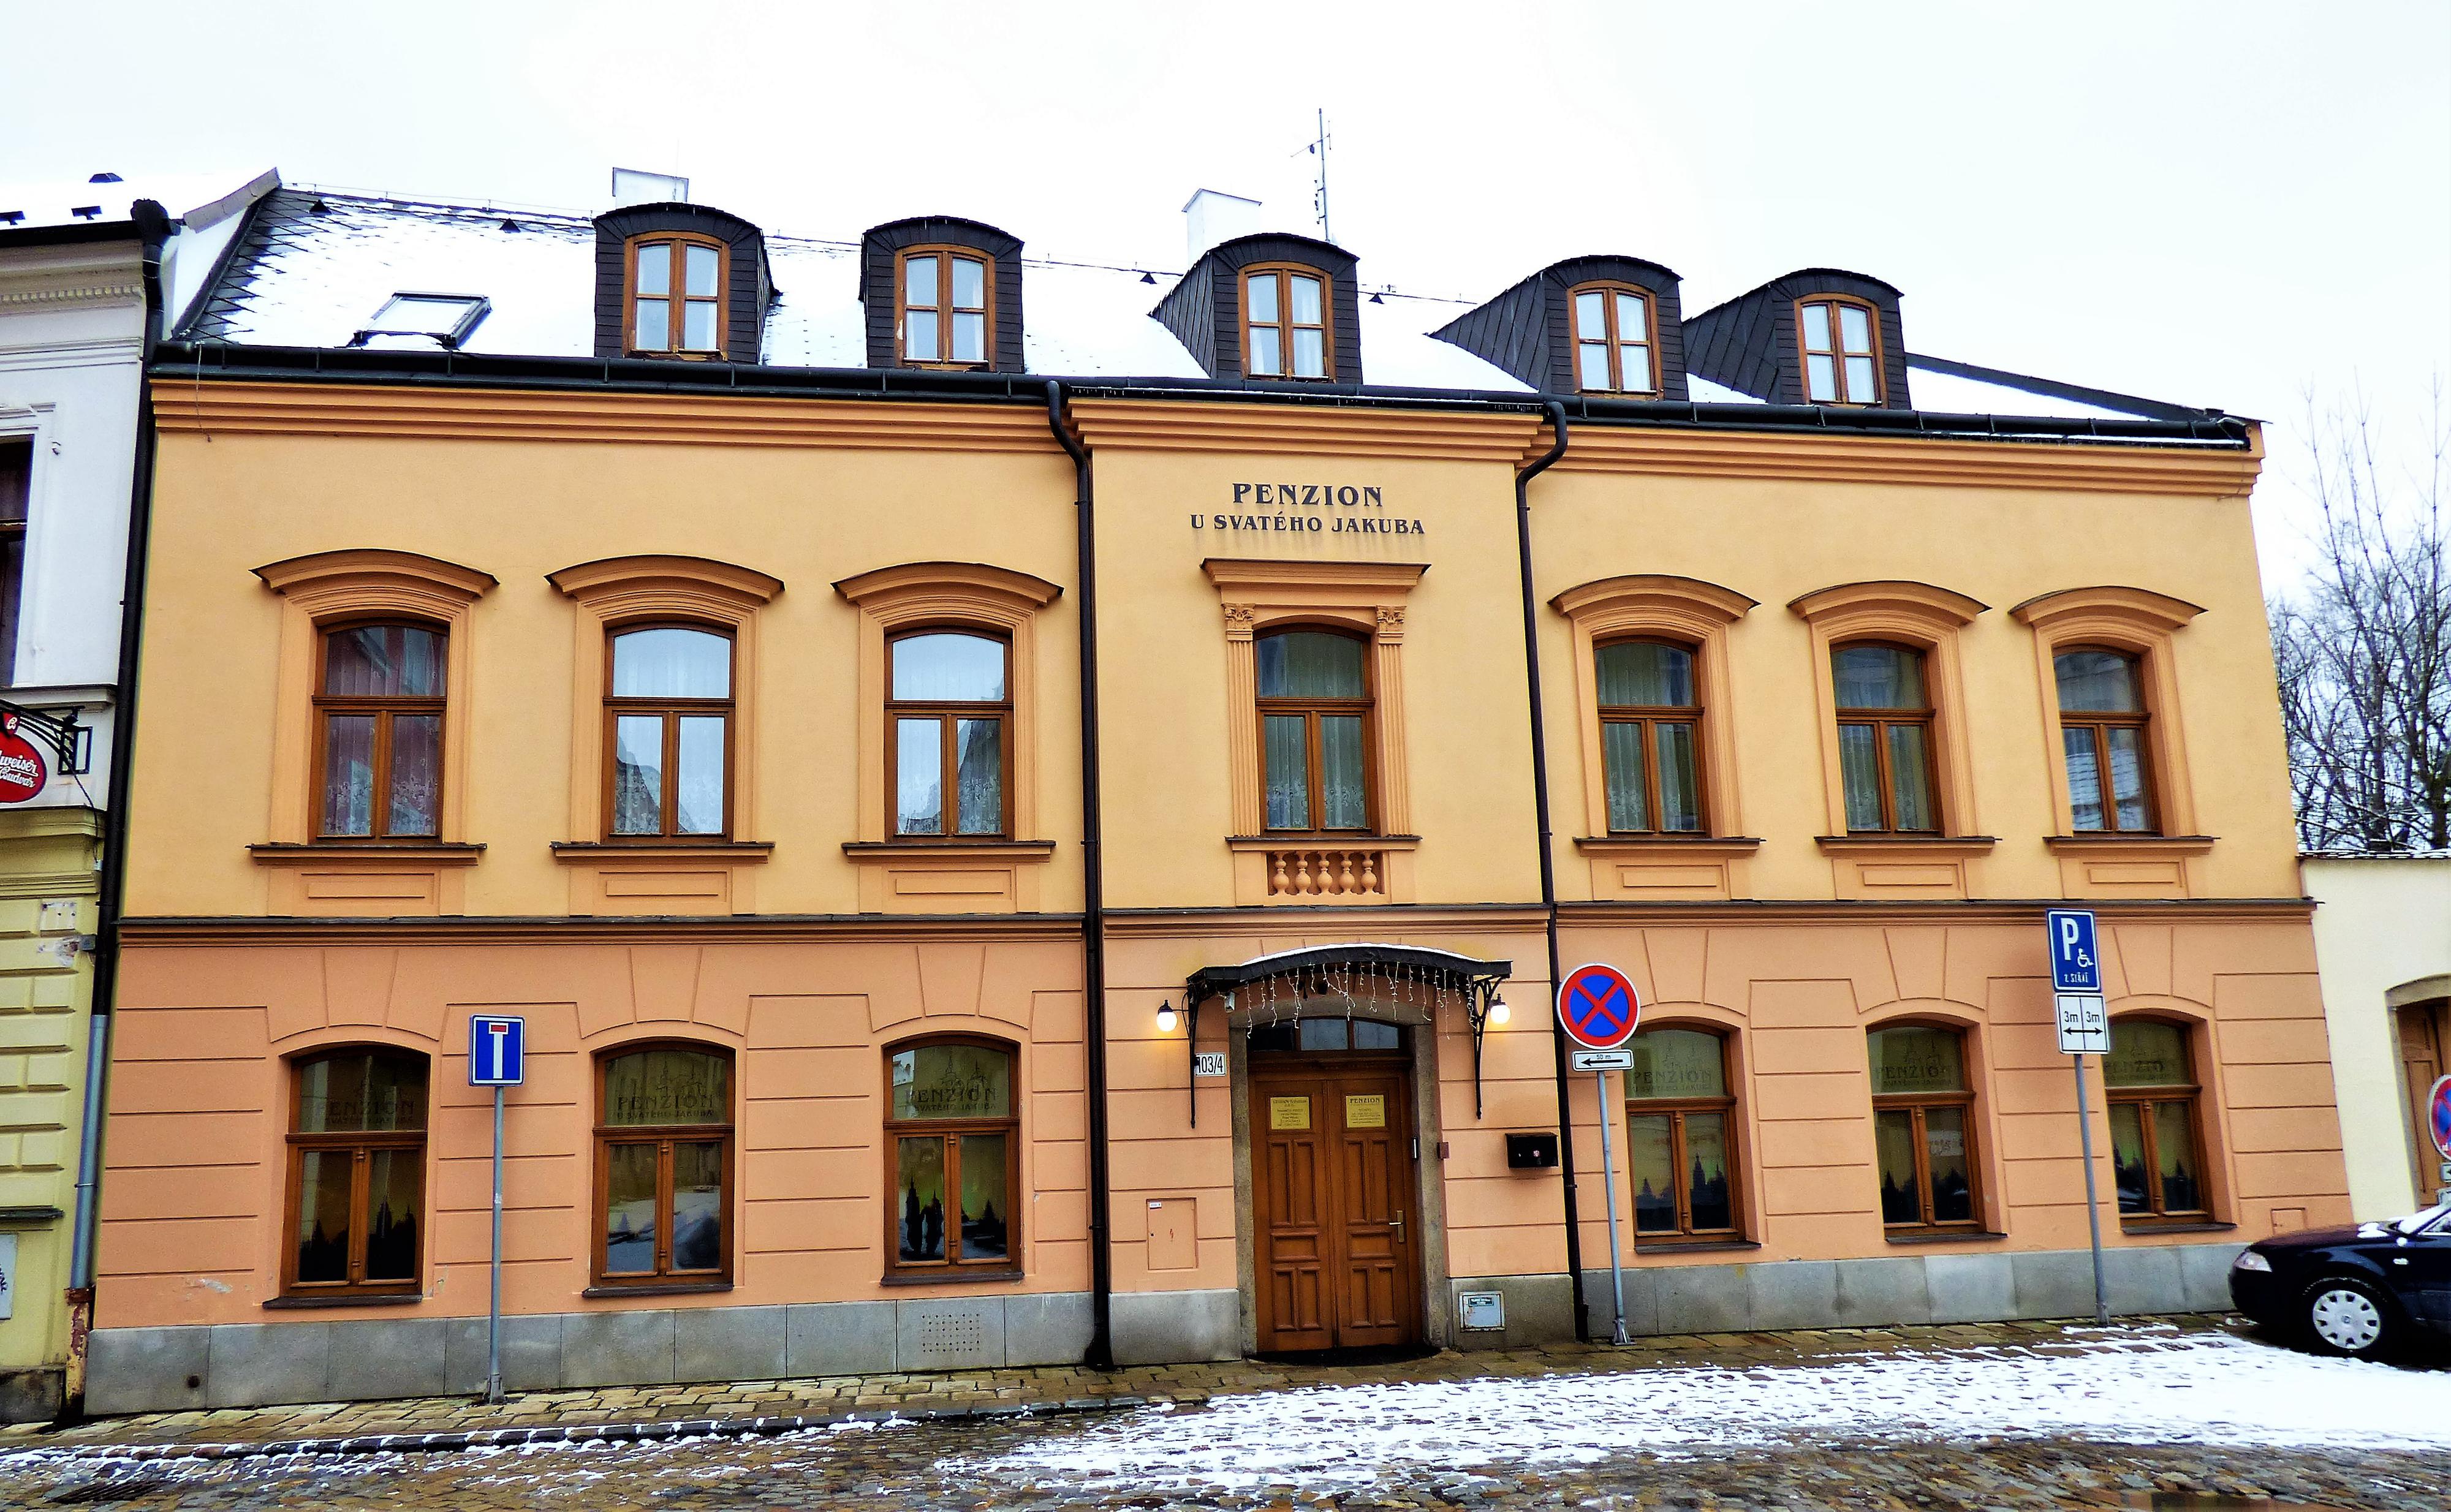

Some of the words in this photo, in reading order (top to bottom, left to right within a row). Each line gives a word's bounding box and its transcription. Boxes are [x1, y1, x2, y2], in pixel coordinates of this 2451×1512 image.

[1232, 483, 1383, 507] PENZION
[1190, 514, 1204, 529] U
[1213, 512, 1323, 532] SVATÉHO
[1331, 517, 1425, 534] JAKUBA
[0, 750, 37, 774] weiser
[2061, 917, 2078, 961] P
[2064, 1011, 2078, 1022] 3m
[2086, 1011, 2100, 1022] 3m
